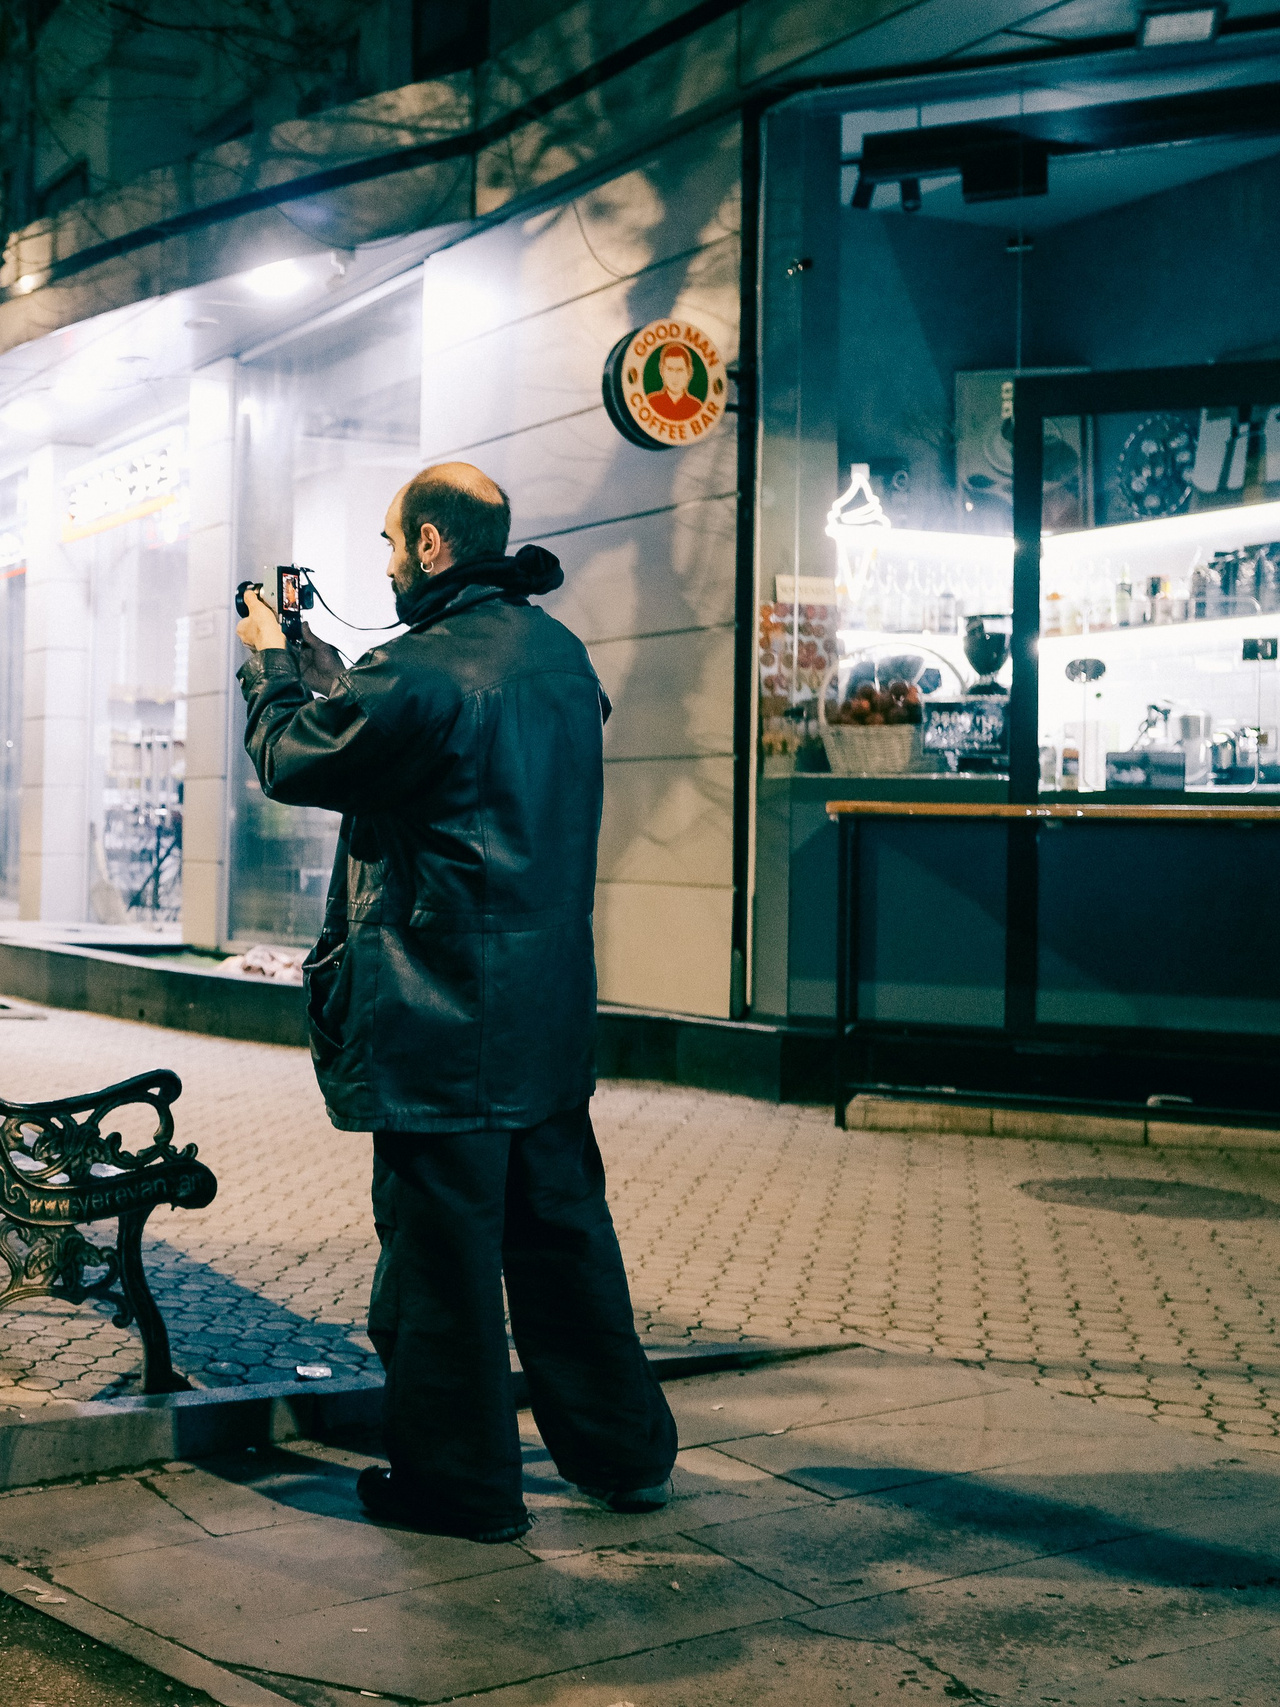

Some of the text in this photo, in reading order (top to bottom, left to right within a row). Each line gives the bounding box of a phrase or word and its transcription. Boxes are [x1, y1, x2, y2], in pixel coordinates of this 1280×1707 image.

[634, 323, 719, 368] GOOD MAN
[630, 393, 719, 440] COFFEE BAR
